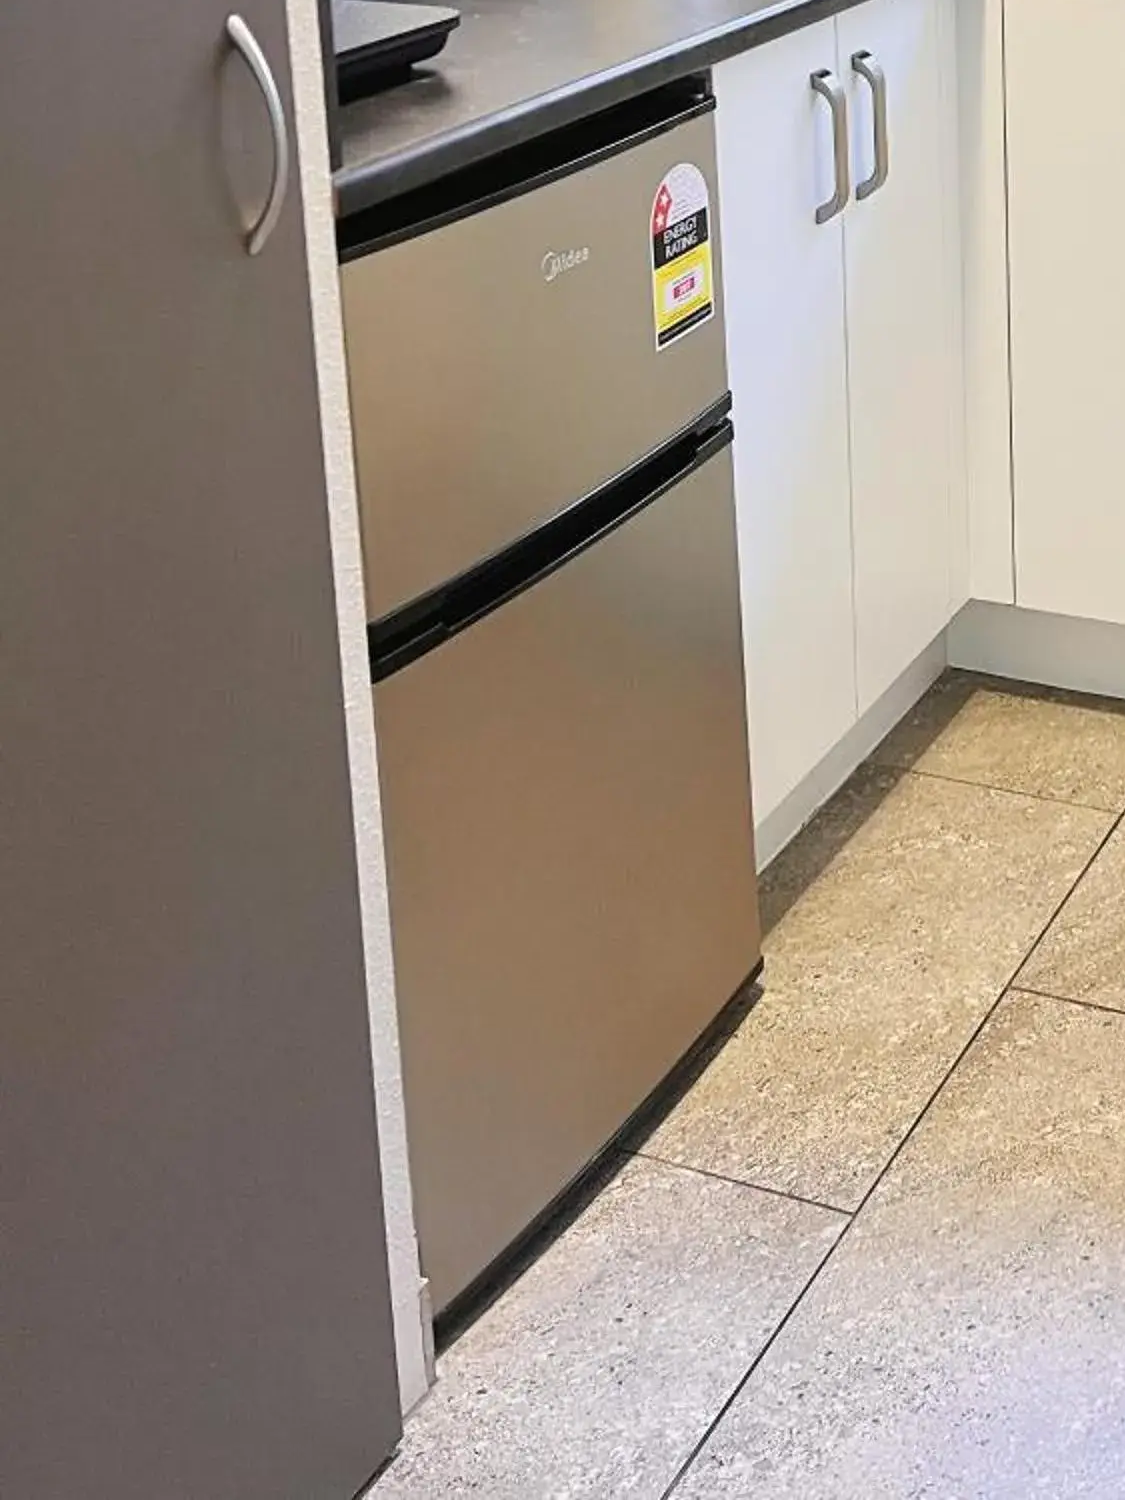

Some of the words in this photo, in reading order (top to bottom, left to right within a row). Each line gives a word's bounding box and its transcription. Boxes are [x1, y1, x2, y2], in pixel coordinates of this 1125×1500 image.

[663, 216, 697, 245] ENERGY
[665, 230, 698, 259] RATING
[541, 247, 589, 282] Midea
